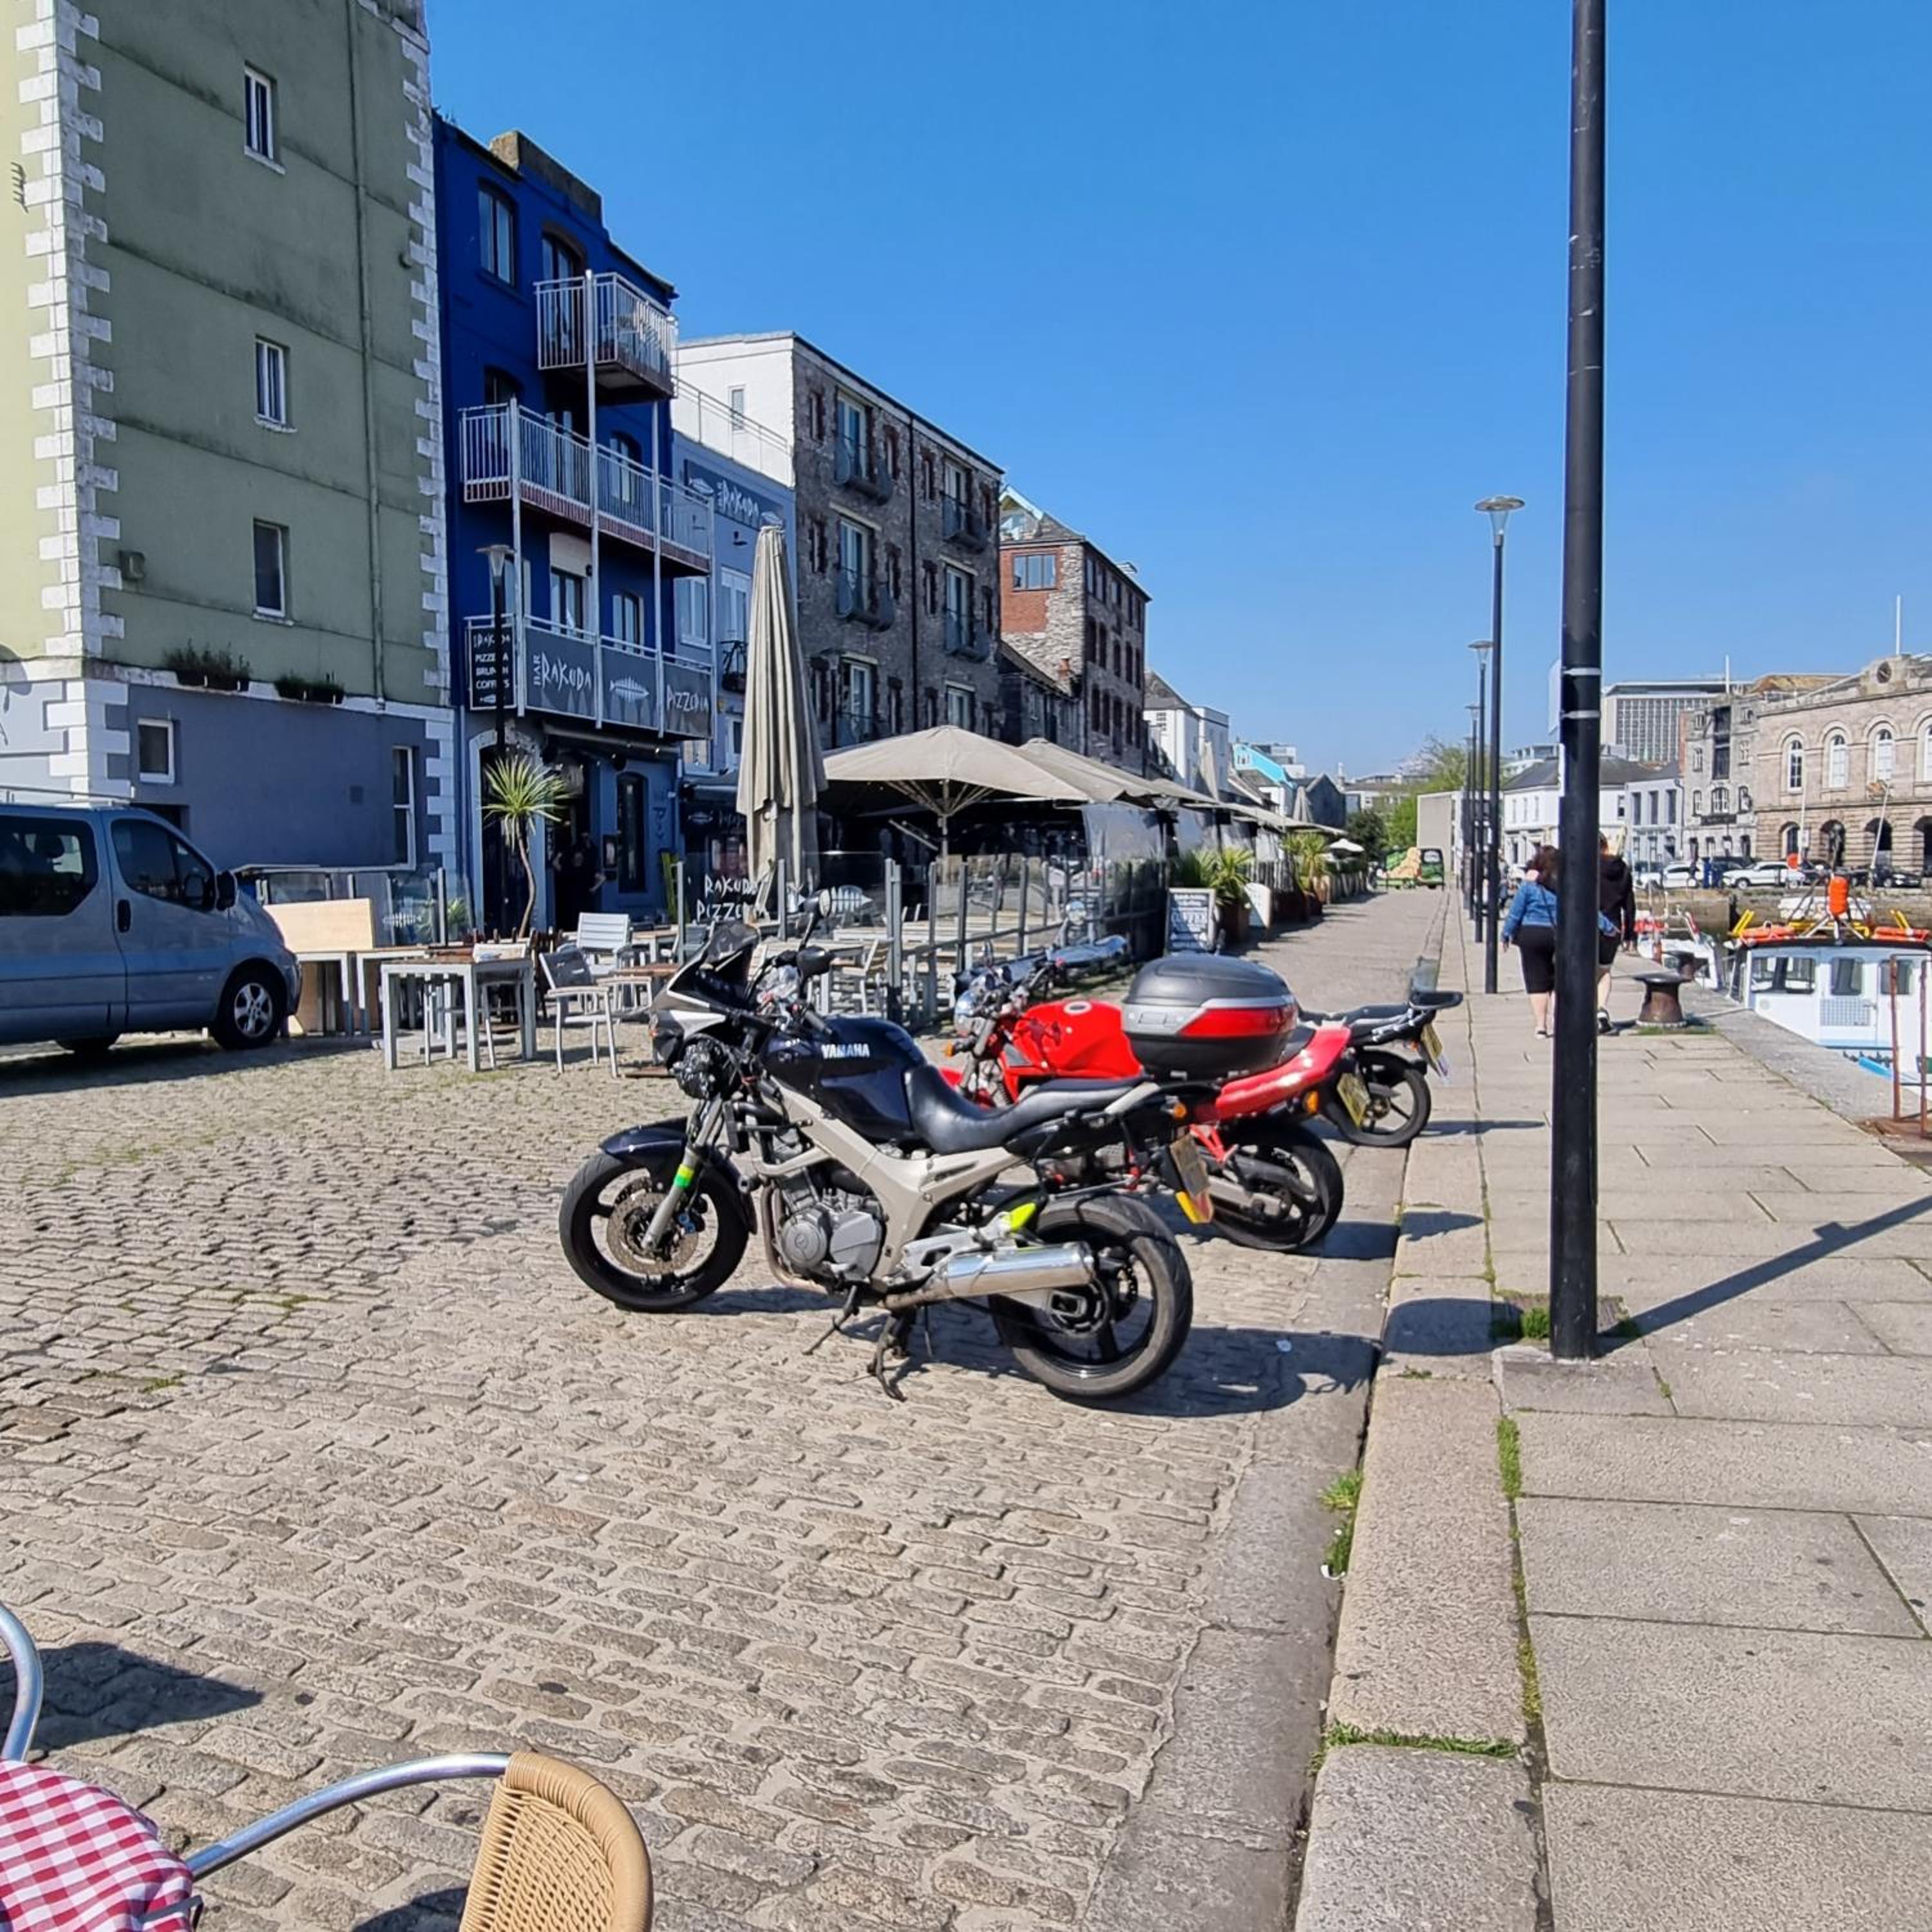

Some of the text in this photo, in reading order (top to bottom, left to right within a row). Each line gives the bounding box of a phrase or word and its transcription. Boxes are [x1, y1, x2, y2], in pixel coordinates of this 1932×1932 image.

[476, 666, 509, 676] BRUNH
[542, 651, 592, 691] RAKUDA
[476, 679, 509, 690] COFFS
[821, 1043, 870, 1059] YAMAHA
